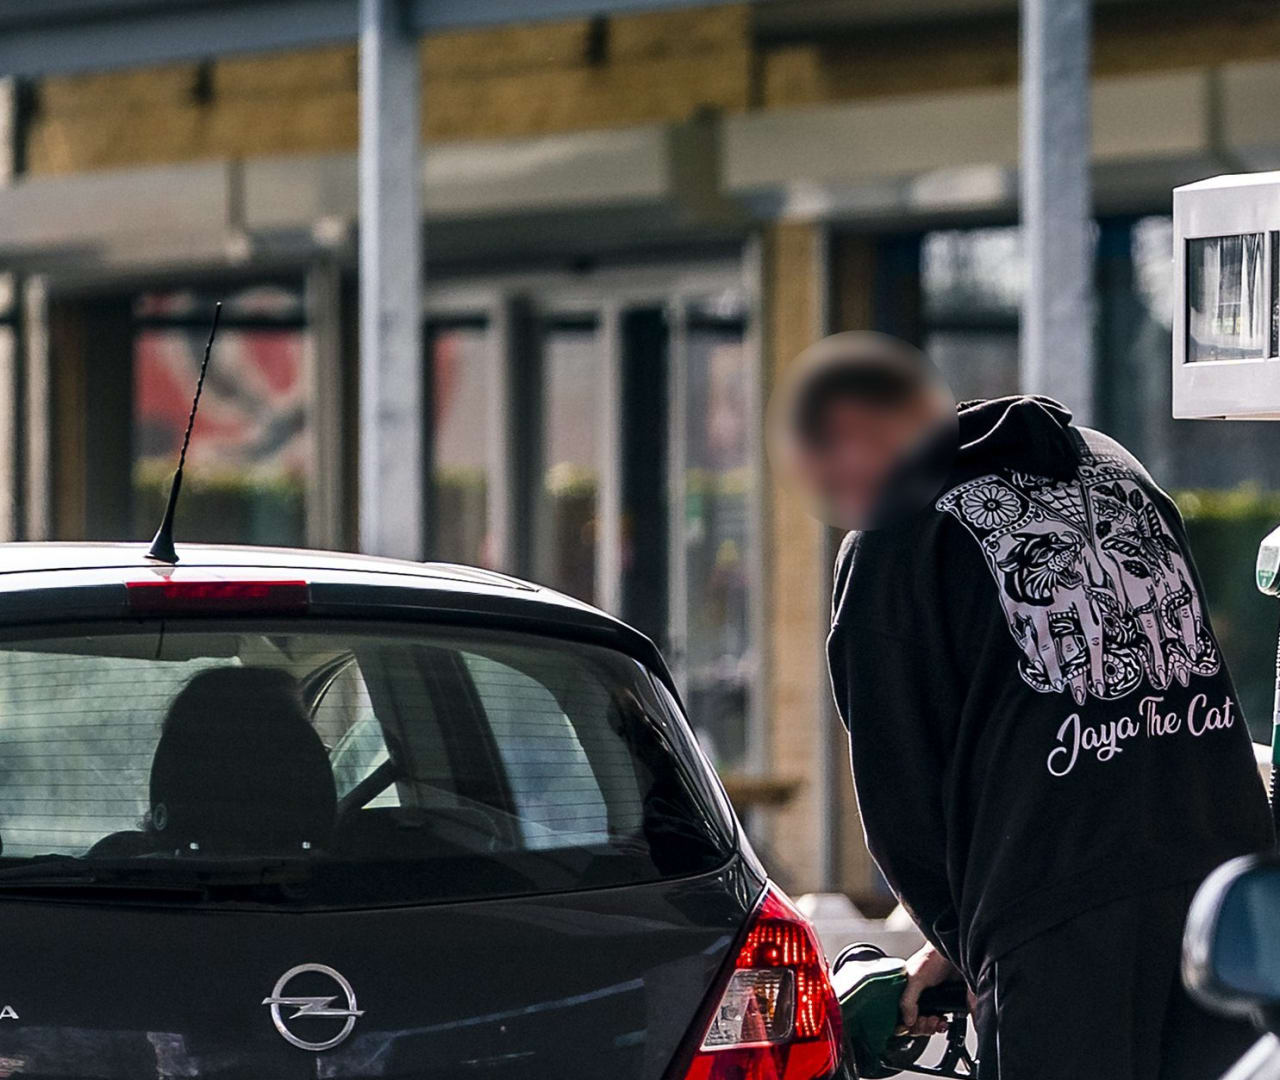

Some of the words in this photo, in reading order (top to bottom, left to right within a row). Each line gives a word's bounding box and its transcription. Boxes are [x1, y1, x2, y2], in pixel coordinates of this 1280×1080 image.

[1047, 713, 1140, 777] Jaya
[1139, 696, 1181, 738] The
[1187, 693, 1234, 737] Cat
